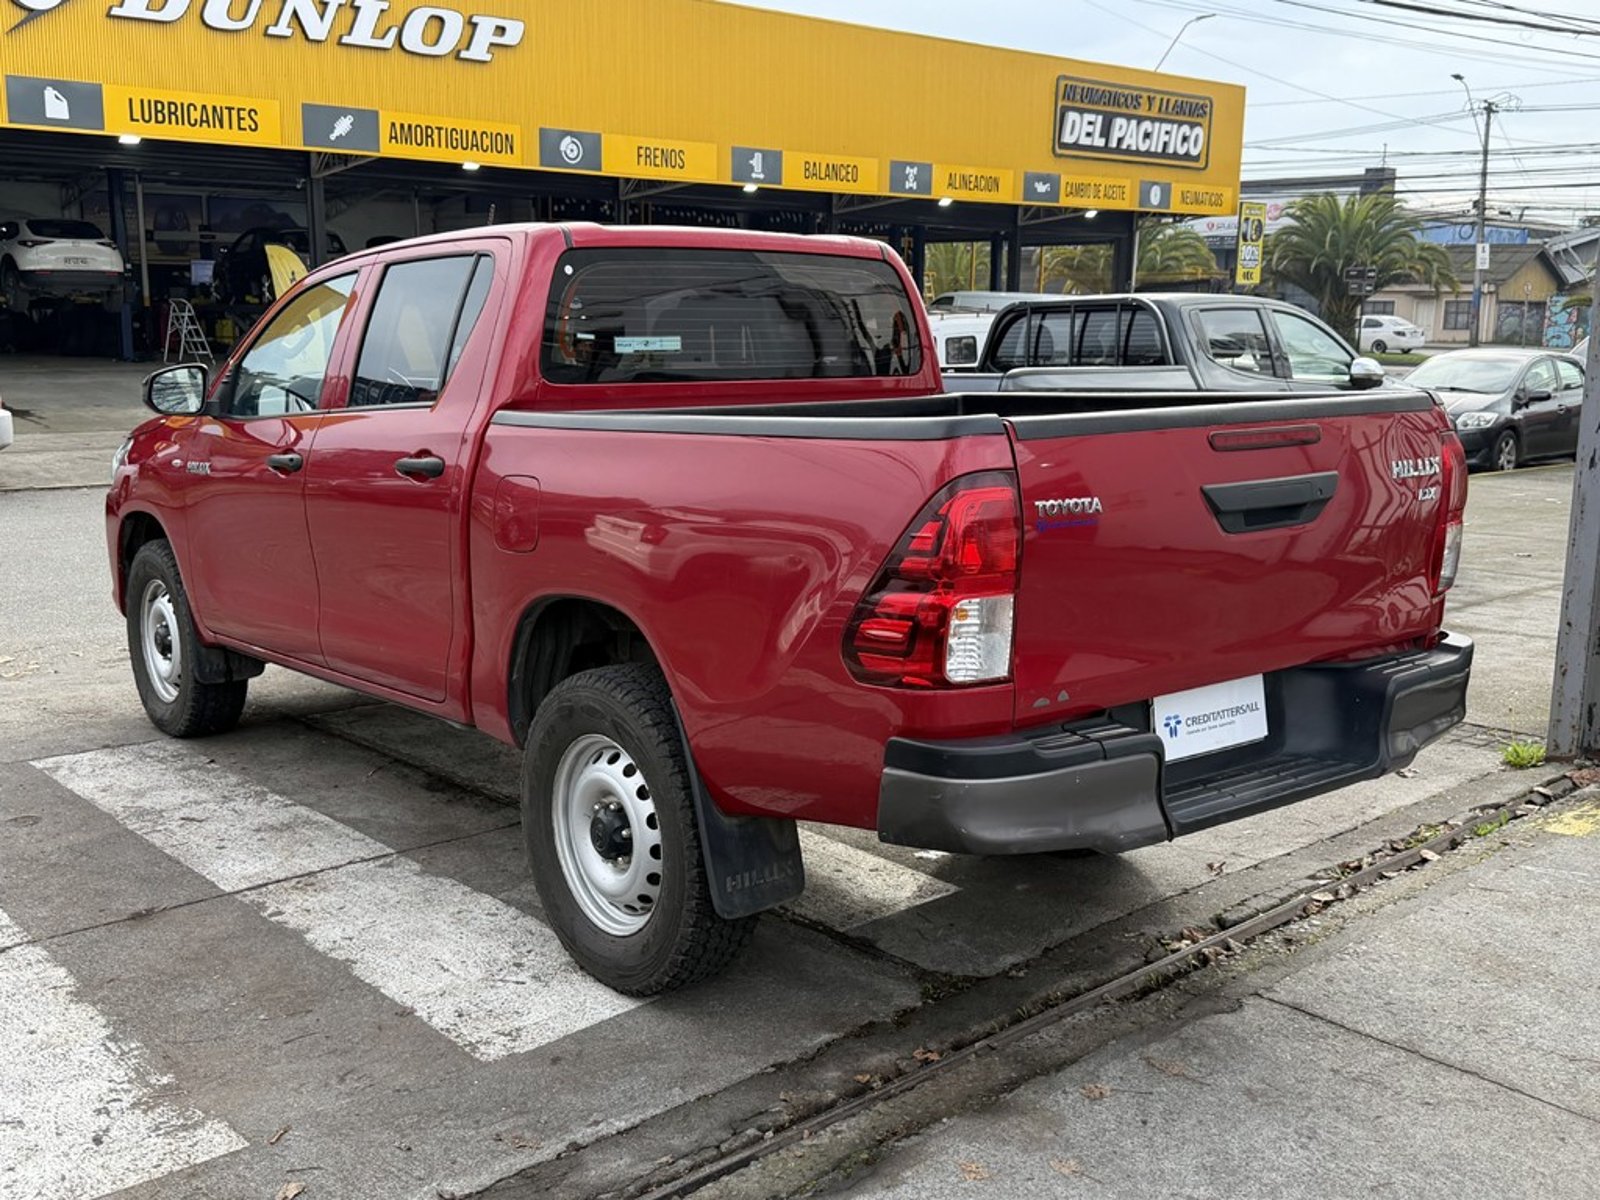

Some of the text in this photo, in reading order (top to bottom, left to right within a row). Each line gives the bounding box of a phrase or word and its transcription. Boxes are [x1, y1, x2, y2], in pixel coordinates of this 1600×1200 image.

[1063, 83, 1142, 110] NEUMATICOS
[1147, 95, 1157, 111] Y
[128, 97, 259, 133] LUBRICANTES
[388, 121, 516, 156] AMORTIGUACION
[1060, 110, 1204, 157] DEL PACIFICO
[636, 145, 686, 170] FRENOS
[804, 160, 859, 184] BALANCEO
[947, 171, 1000, 193] ALINEACION
[1065, 181, 1126, 201] CAMBIO DE ACEITE
[1180, 190, 1224, 208] NEUMATICOS
[1392, 456, 1440, 479] HILUX
[1034, 496, 1104, 518] TOYOTA
[1185, 701, 1260, 728] CREDITATTERSALL
